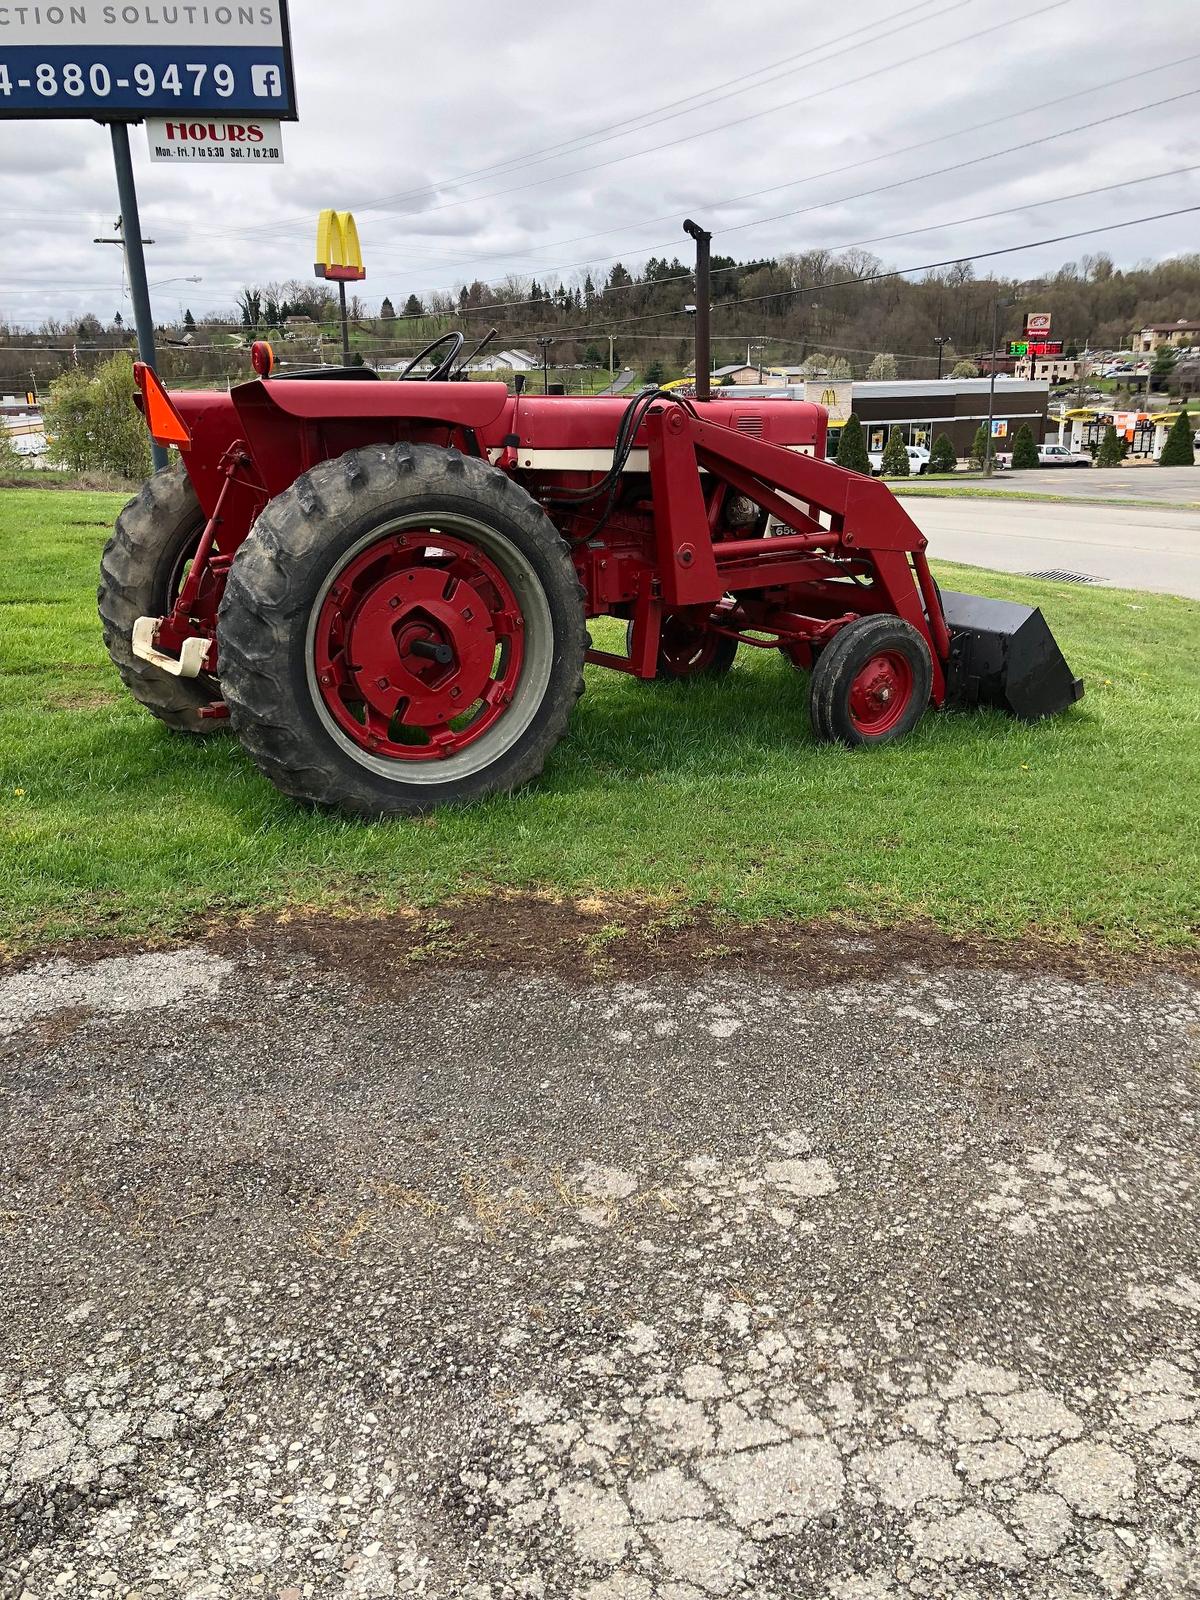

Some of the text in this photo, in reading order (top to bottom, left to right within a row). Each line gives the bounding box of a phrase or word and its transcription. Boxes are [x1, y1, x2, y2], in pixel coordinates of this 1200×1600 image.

[0, 5, 274, 26] CTION SOLUTIONS
[0, 63, 235, 98] 4-880-9479
[165, 122, 265, 143] HOURS
[177, 146, 190, 158] Fri.
[191, 146, 196, 158] 7
[198, 147, 206, 158] to
[207, 147, 225, 158] 5:30
[230, 147, 245, 159] Sat.
[246, 147, 251, 158] 7
[253, 147, 260, 159] to
[262, 148, 279, 159] 2:00
